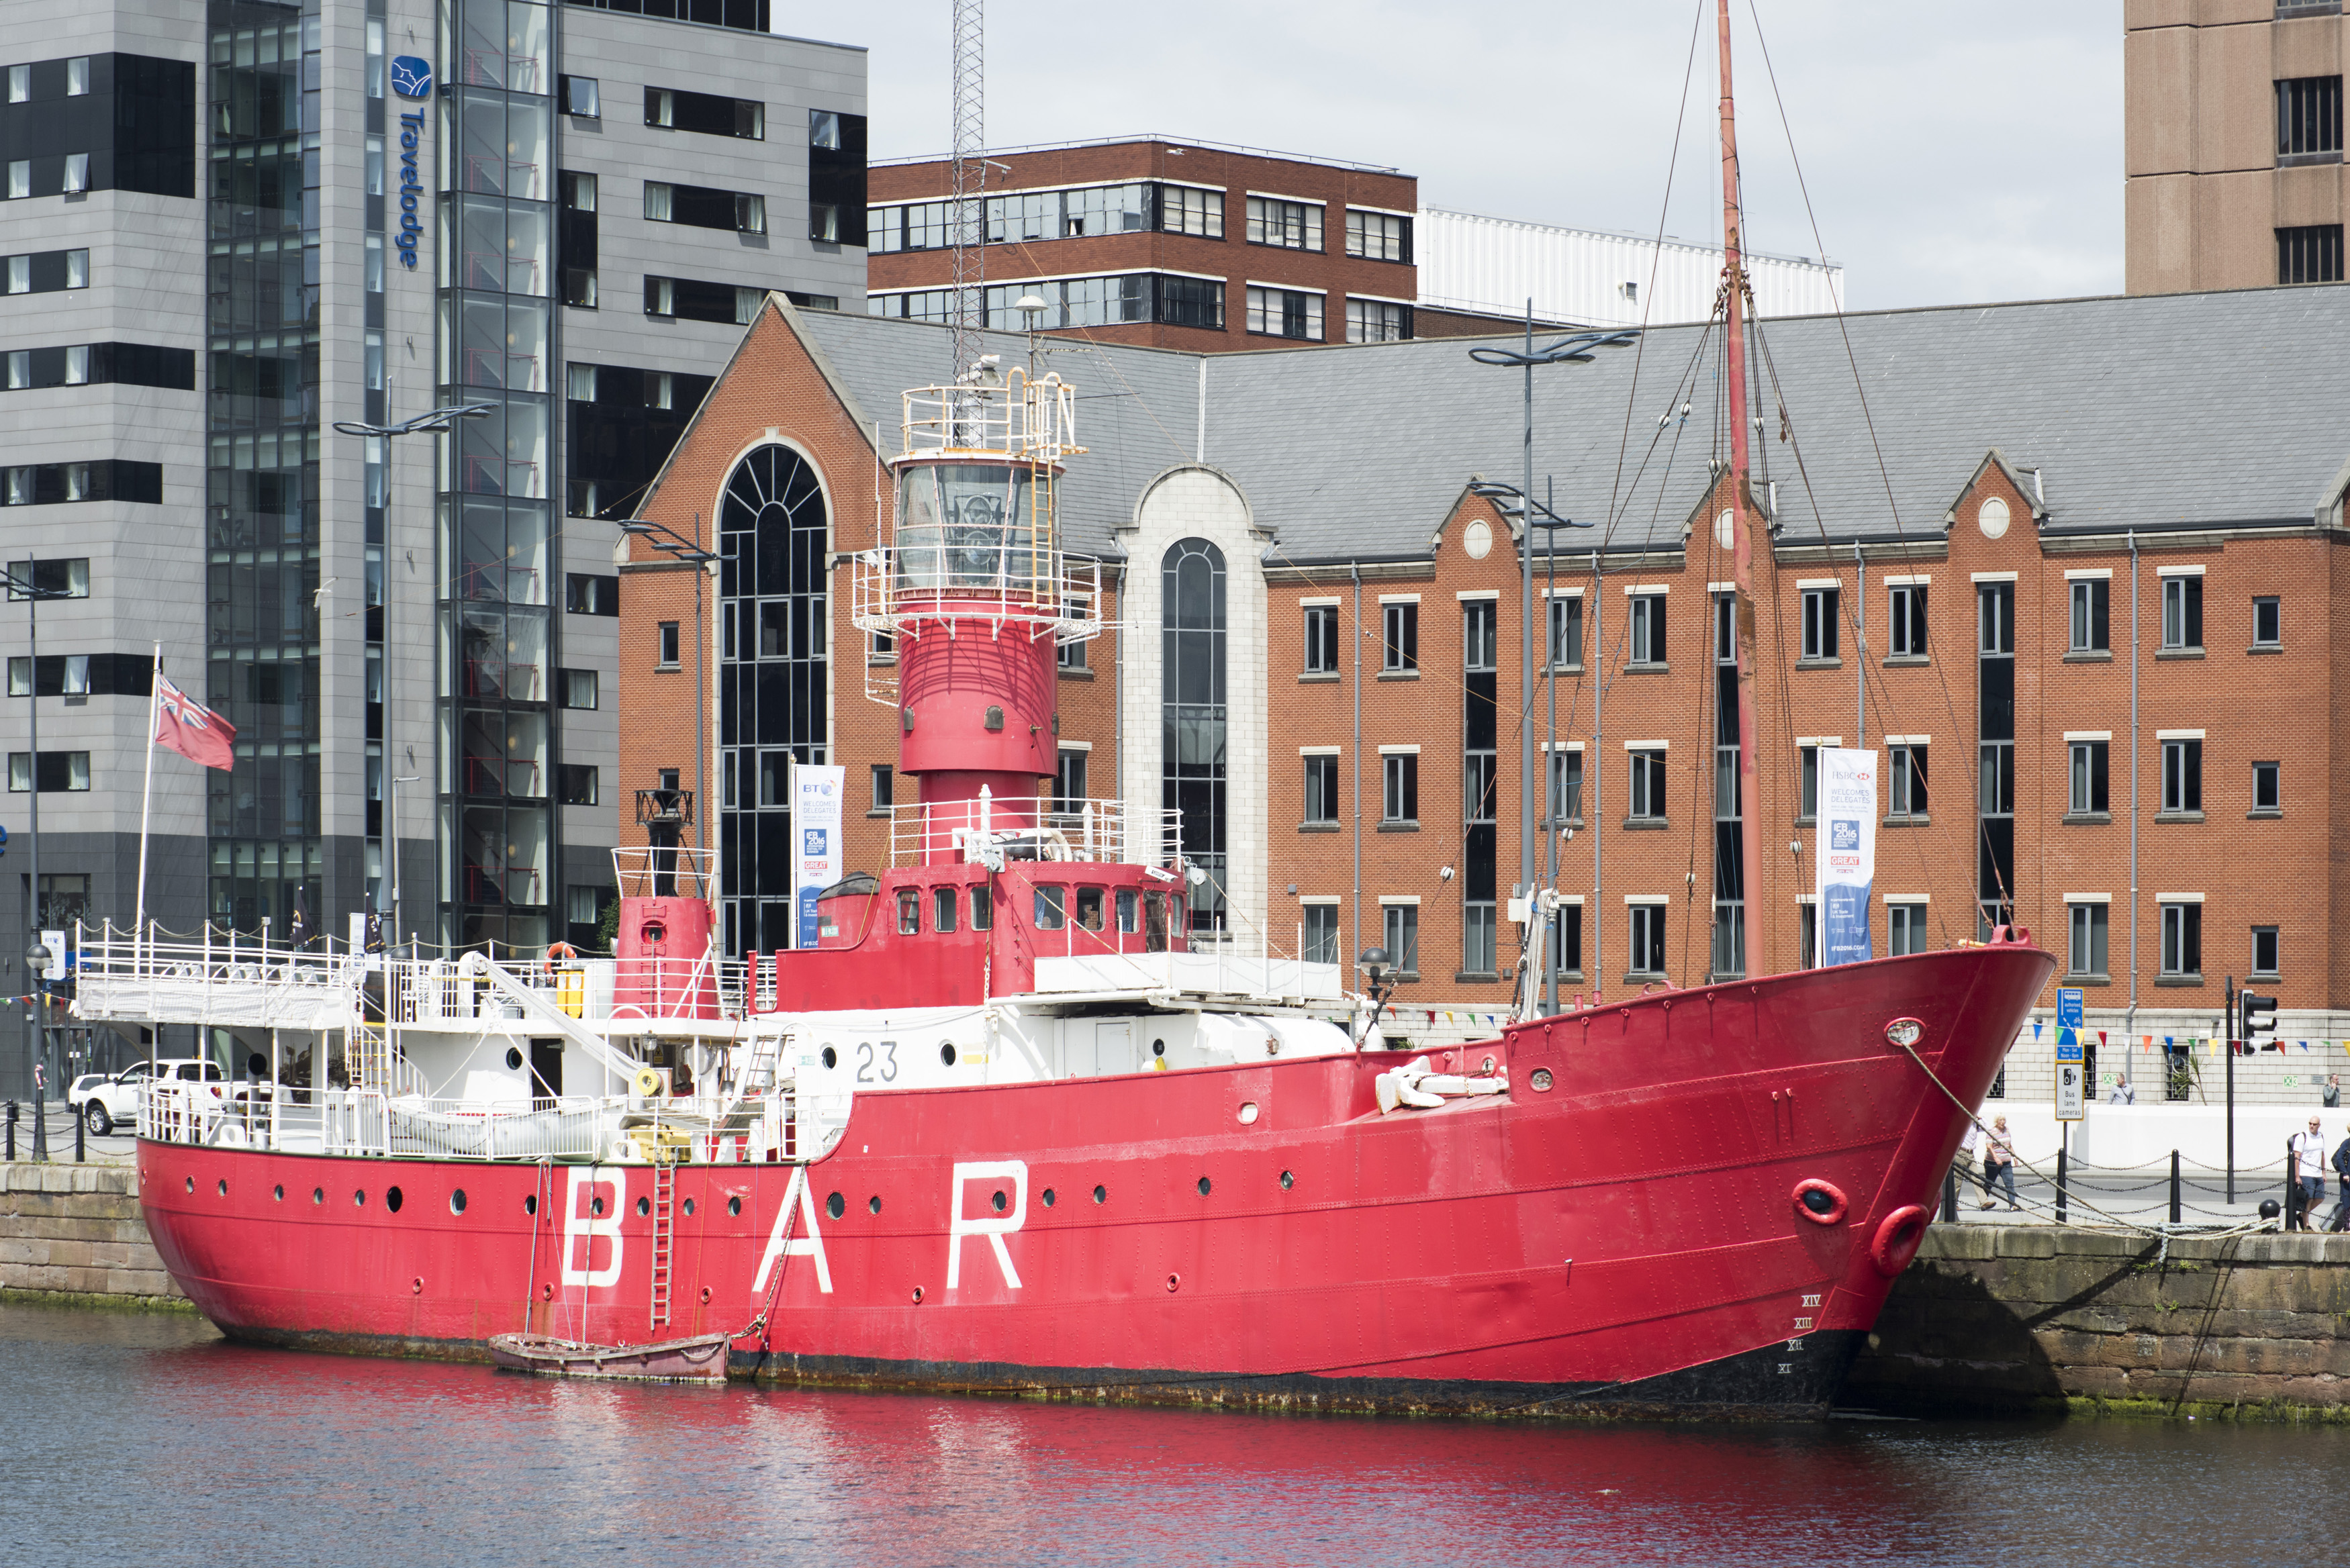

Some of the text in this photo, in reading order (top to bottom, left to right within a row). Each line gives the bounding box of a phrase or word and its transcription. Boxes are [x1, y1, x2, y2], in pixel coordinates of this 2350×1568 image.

[395, 107, 424, 266] Travelodge
[1832, 771, 1855, 779] HSBC
[803, 785, 820, 793] BT
[1836, 830, 1857, 838] 2016
[808, 837, 825, 845] 2016
[1831, 856, 1859, 865] GREAT
[857, 1041, 897, 1083] 23
[562, 1159, 1028, 1293] BAR
[1801, 1294, 1822, 1307] XIV
[1793, 1317, 1812, 1329] XIII
[1787, 1339, 1804, 1351] XII
[1777, 1363, 1792, 1373] XI
